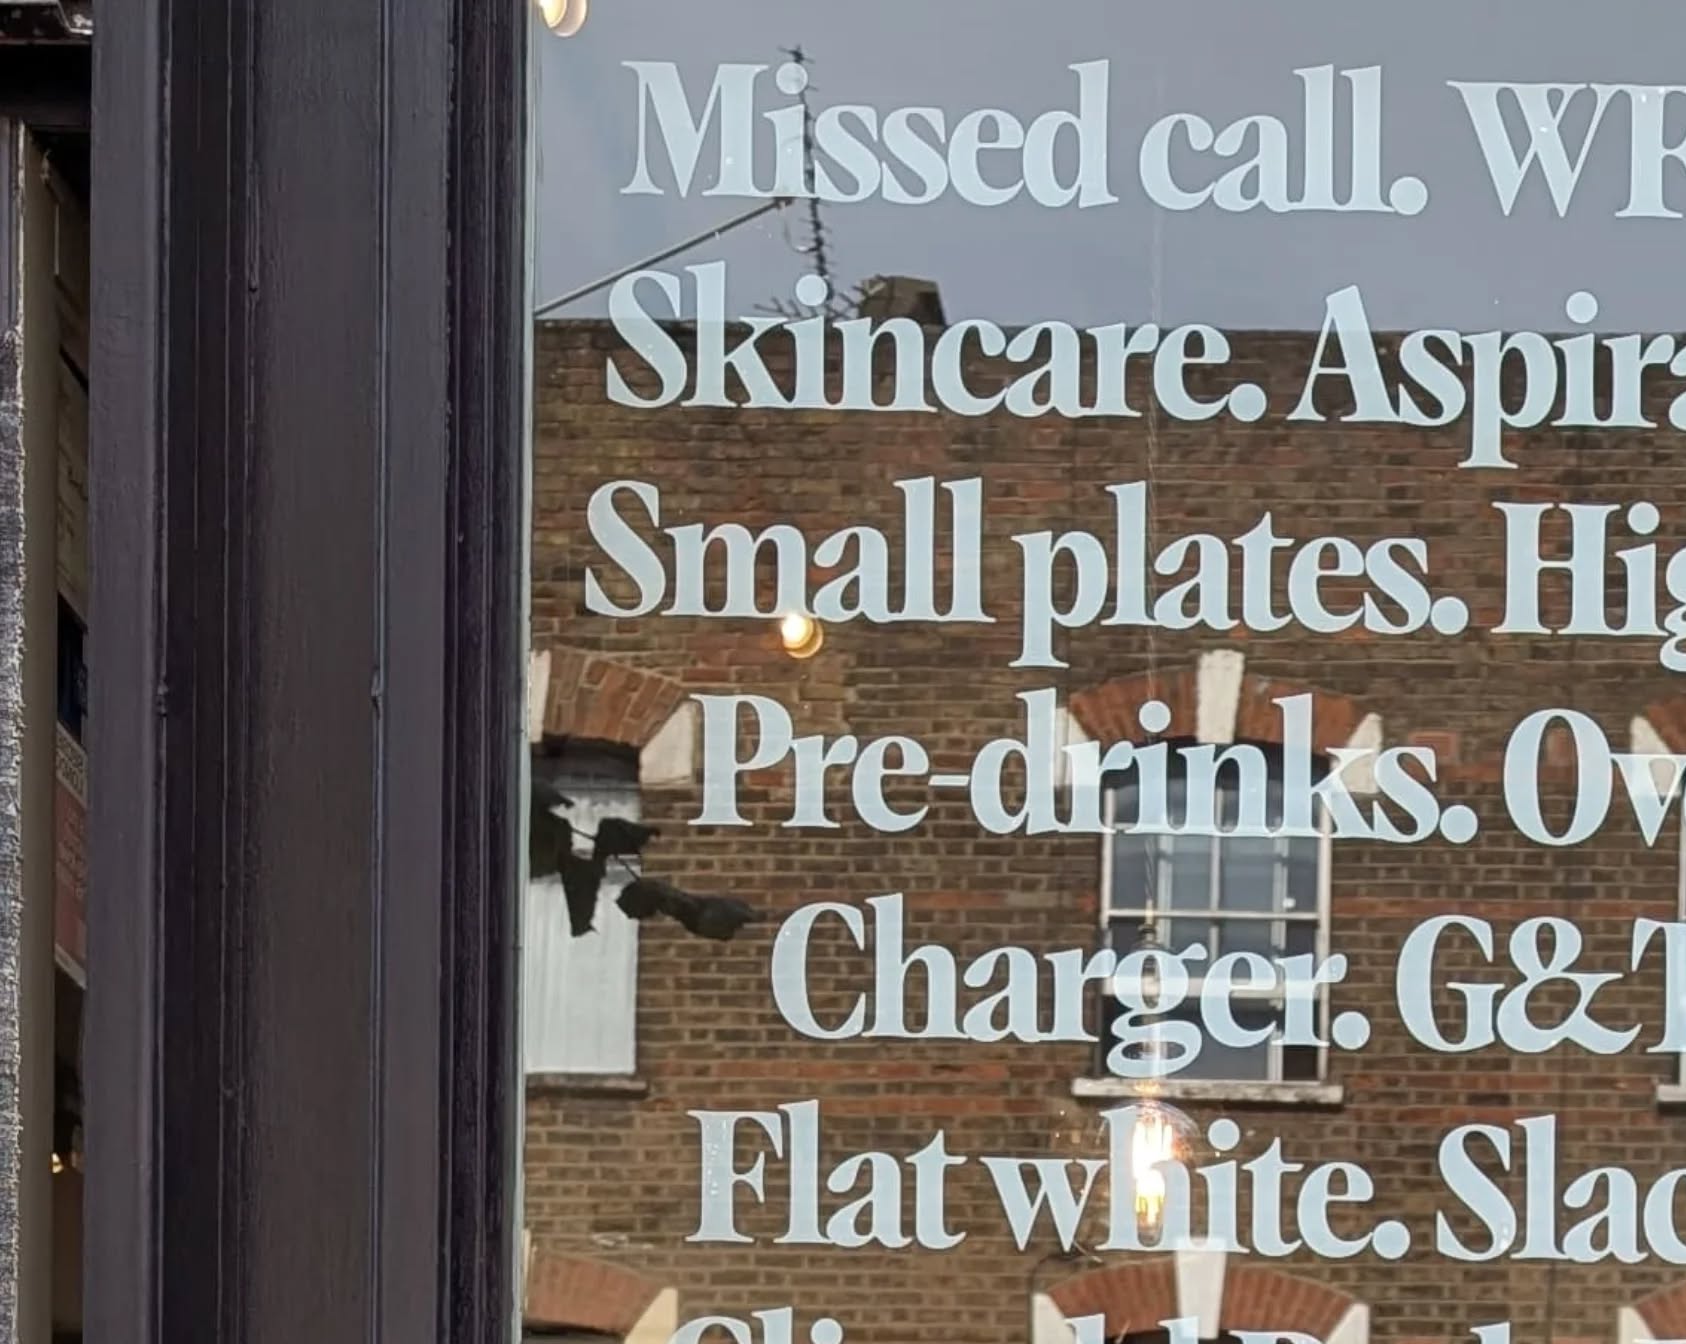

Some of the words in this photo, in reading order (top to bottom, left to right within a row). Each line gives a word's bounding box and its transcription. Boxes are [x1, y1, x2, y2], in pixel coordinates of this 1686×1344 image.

[620, 59, 1119, 207] Missed
[1139, 64, 1428, 216] call.
[605, 260, 1267, 424] Skincare.
[584, 474, 995, 624] Small
[1009, 481, 1468, 669] plates.
[687, 687, 1480, 845] Pre-drinks.
[771, 892, 1370, 1081] Charger.
[685, 1099, 966, 1251] Flat
[980, 1107, 1413, 1260] white.
